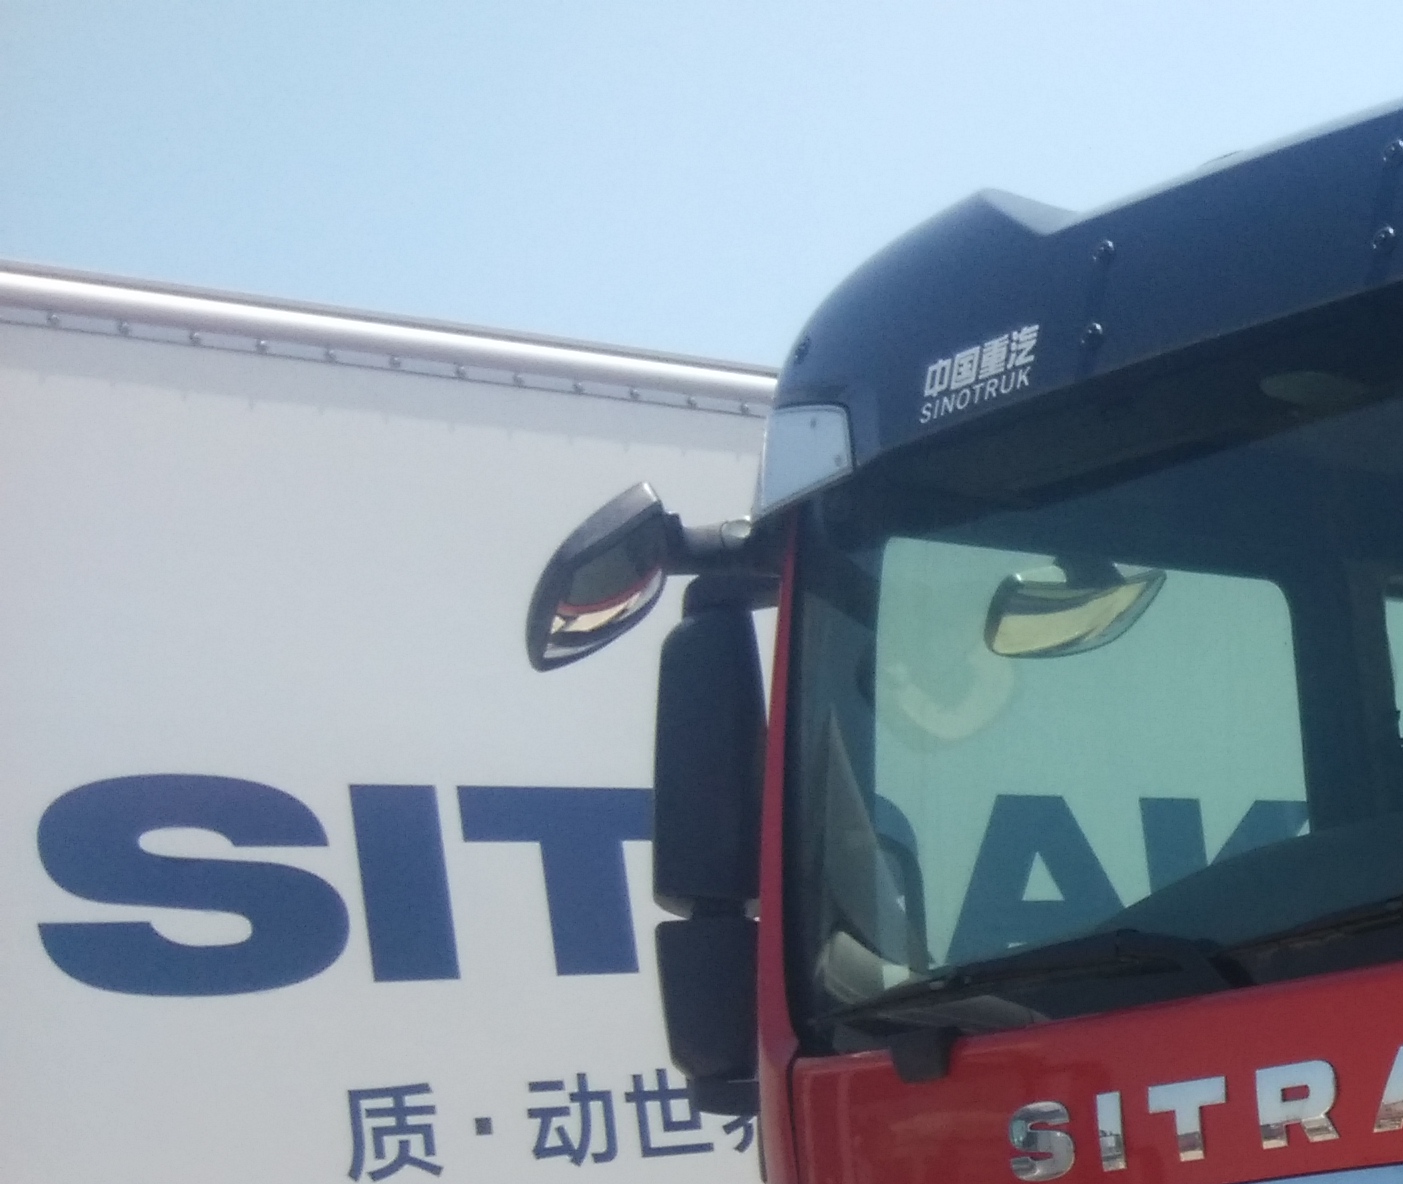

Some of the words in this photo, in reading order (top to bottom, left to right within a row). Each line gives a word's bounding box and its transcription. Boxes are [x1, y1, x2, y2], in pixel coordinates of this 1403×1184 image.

[923, 324, 1040, 398] 中国重汽
[918, 366, 1032, 424] SINOTRUK
